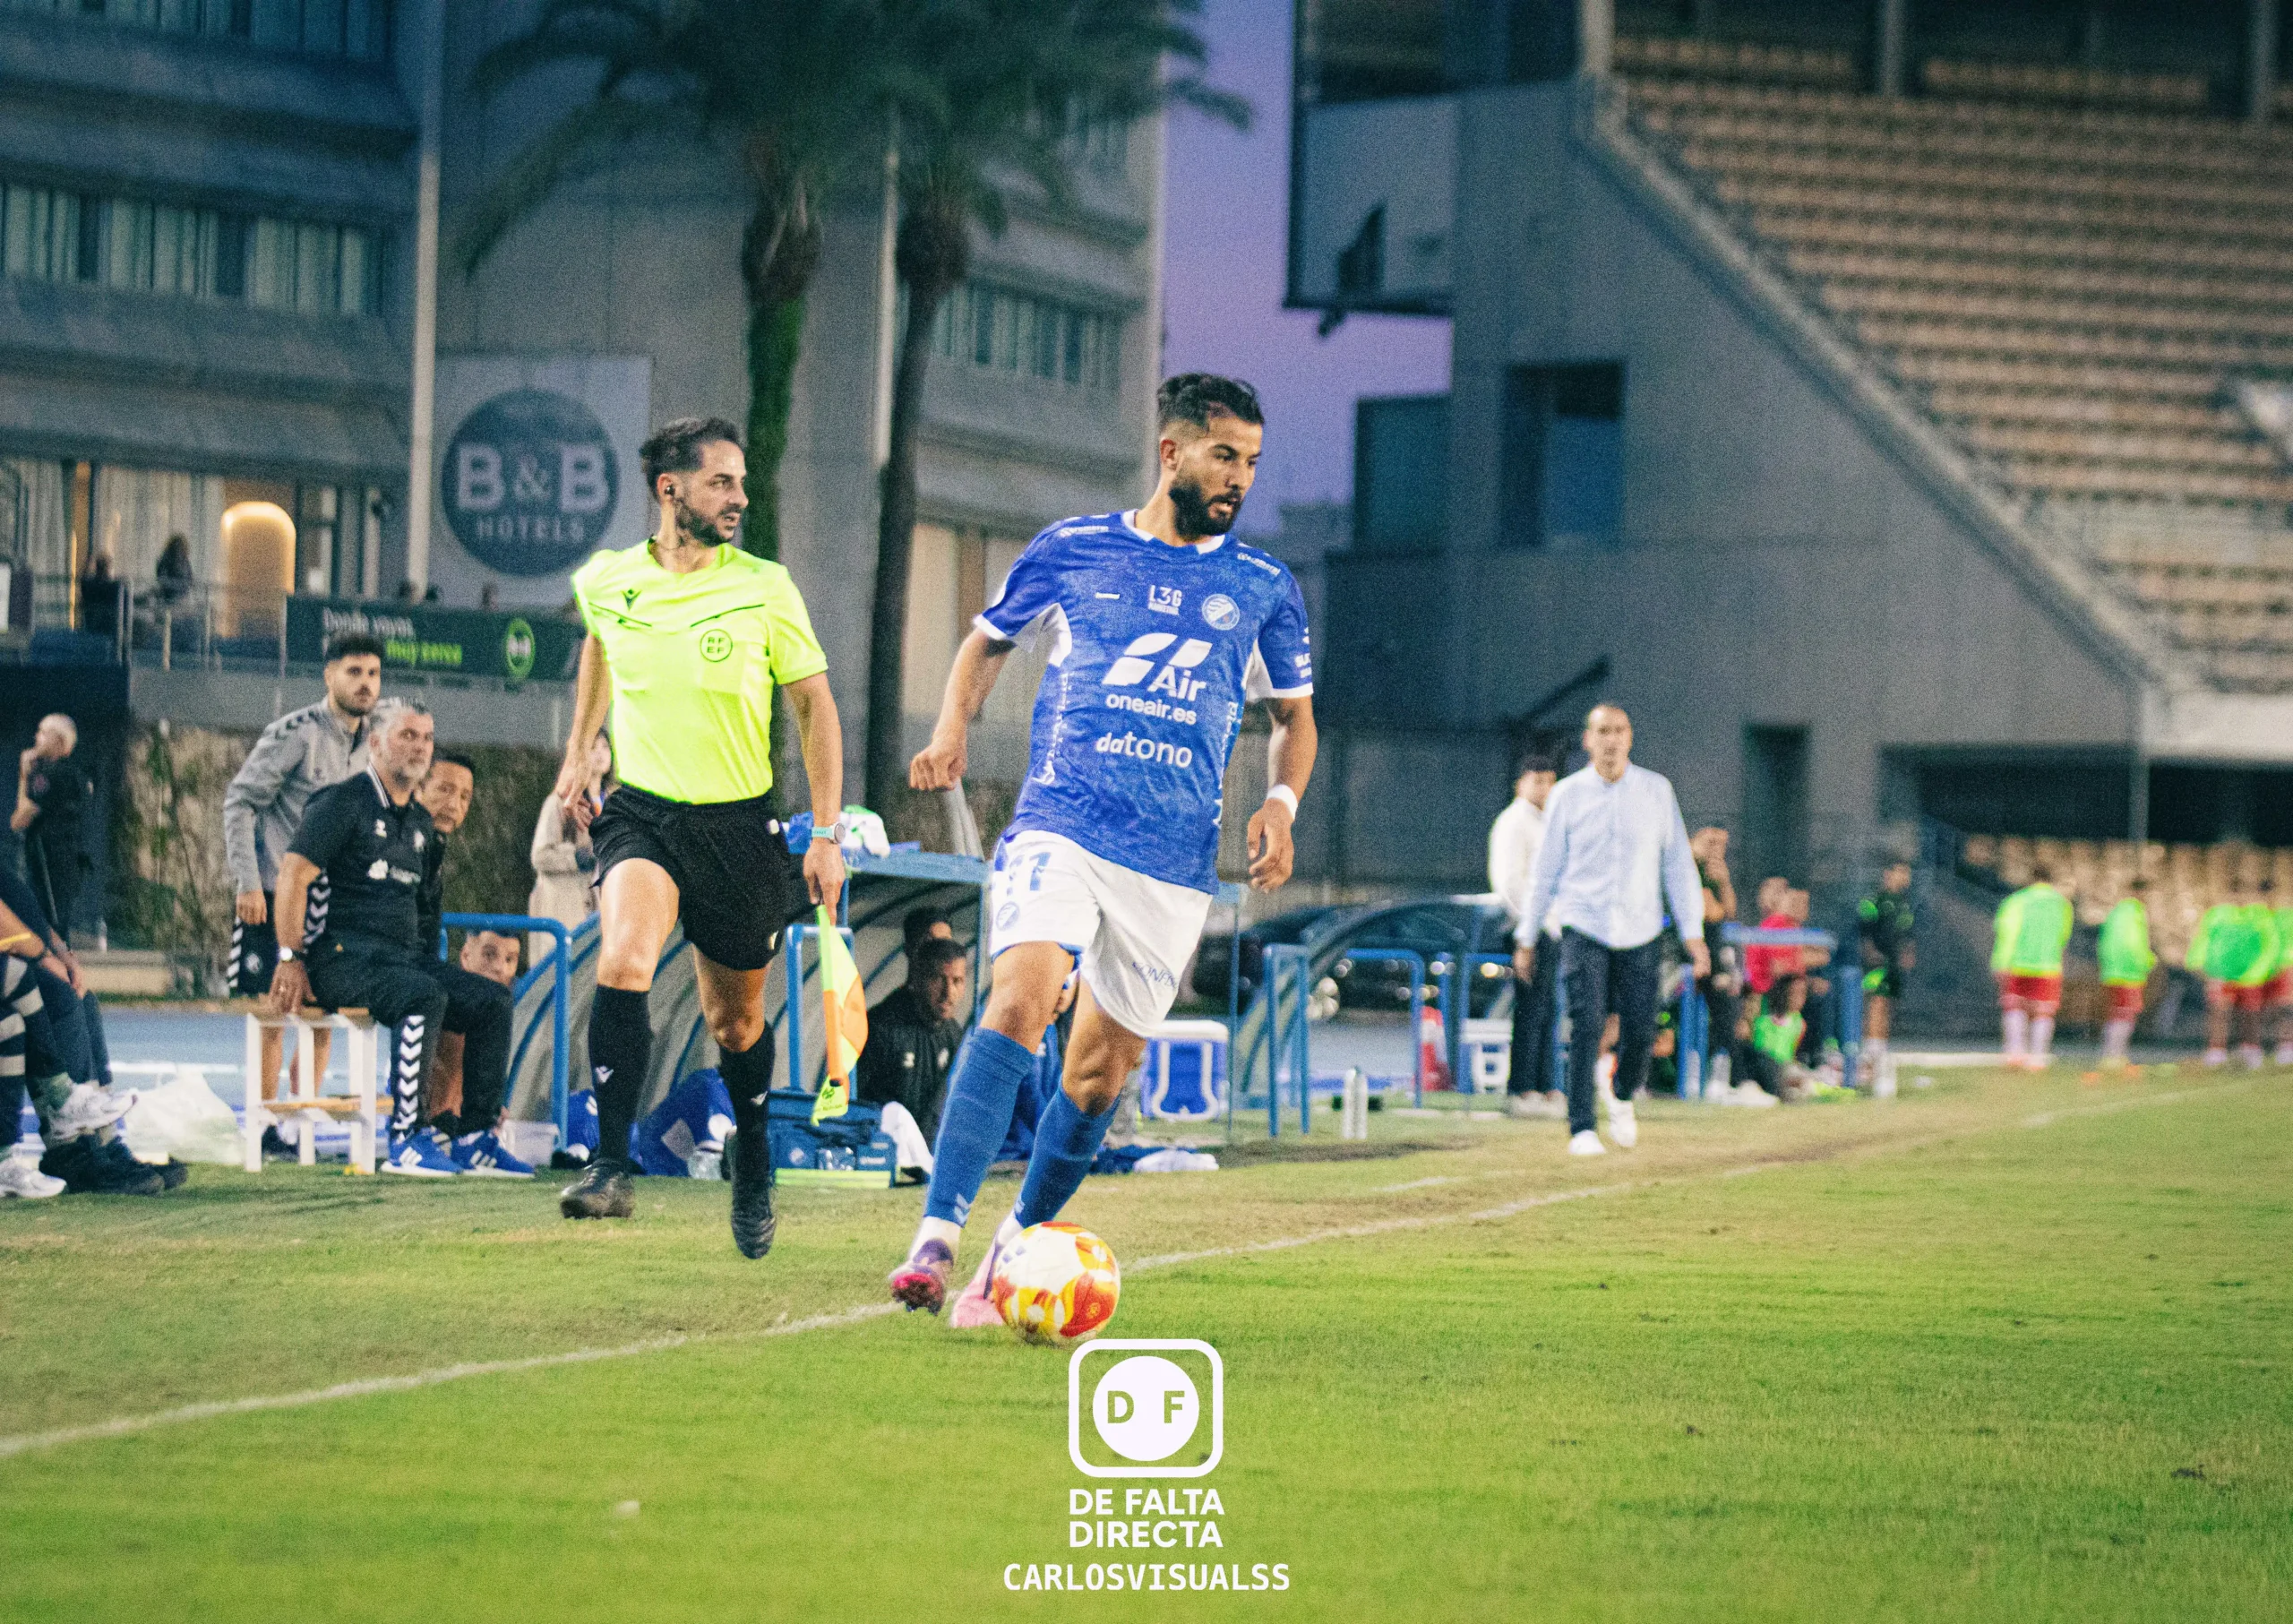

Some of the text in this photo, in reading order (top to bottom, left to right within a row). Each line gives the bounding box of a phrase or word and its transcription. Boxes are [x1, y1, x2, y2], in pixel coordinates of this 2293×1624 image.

[458, 443, 609, 512] B&B
[477, 515, 584, 541] HOTELS
[1147, 666, 1207, 701] Air
[1105, 693, 1197, 725] oneair.es
[1095, 731, 1193, 768] datono
